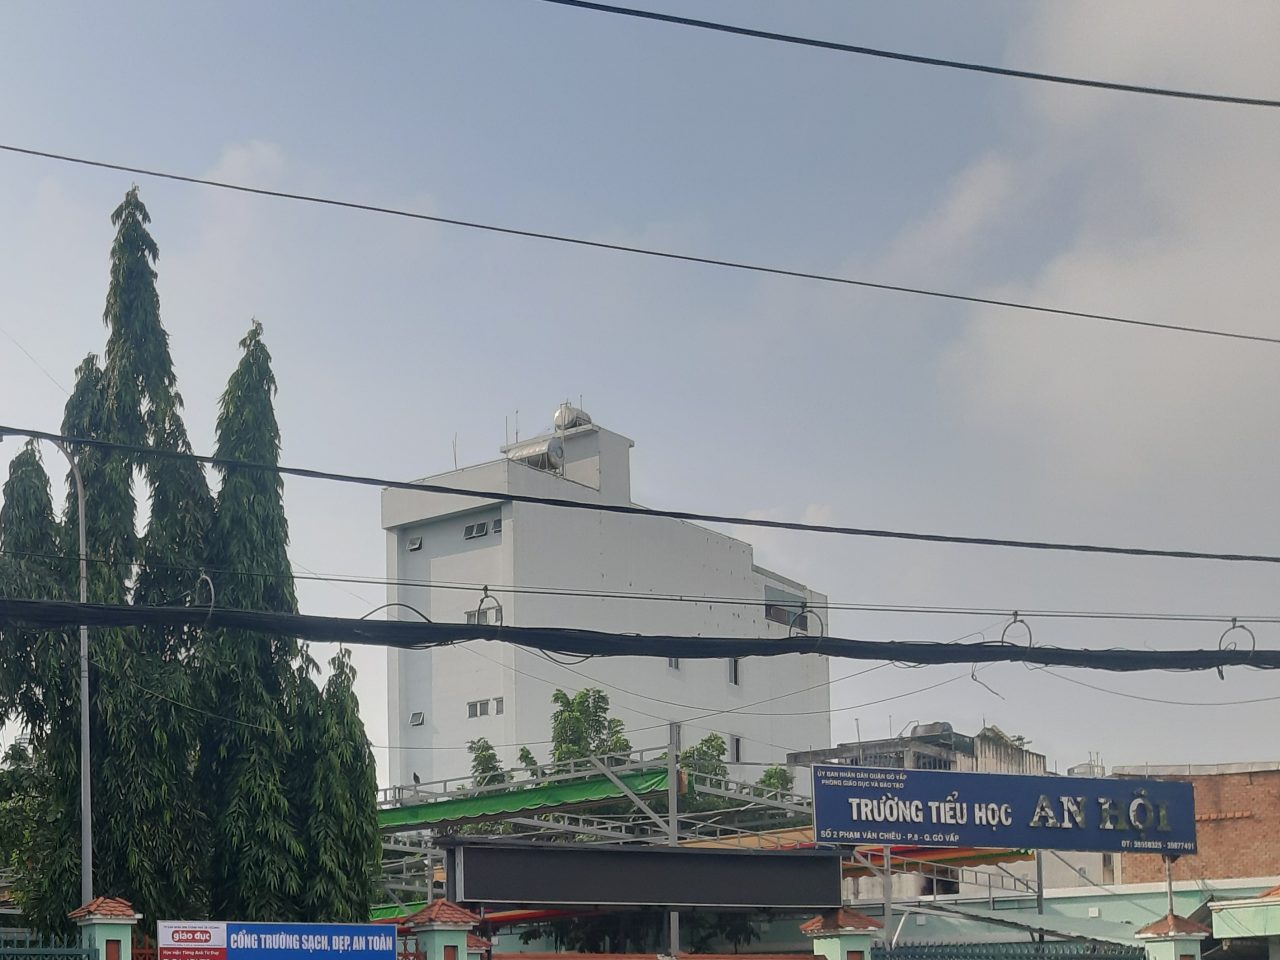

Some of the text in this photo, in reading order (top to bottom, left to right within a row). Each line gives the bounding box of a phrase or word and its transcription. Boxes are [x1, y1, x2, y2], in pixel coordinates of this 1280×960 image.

[871, 780, 879, 788] VÀ
[848, 788, 1171, 839] TRƯỜNG TIỂU HỌC AN HỘI
[820, 828, 832, 838] SỐ
[839, 831, 860, 839] PHẠM
[862, 830, 877, 839] VĂN
[879, 831, 901, 840] CHIÊU
[945, 832, 960, 842] VẤP
[173, 931, 210, 942] giáo dục
[230, 930, 258, 949] CỔNG
[260, 932, 300, 949] TRƯỜNG
[301, 934, 331, 952] SẠCH,
[353, 935, 366, 950] AN
[367, 933, 393, 951] TOÀN
